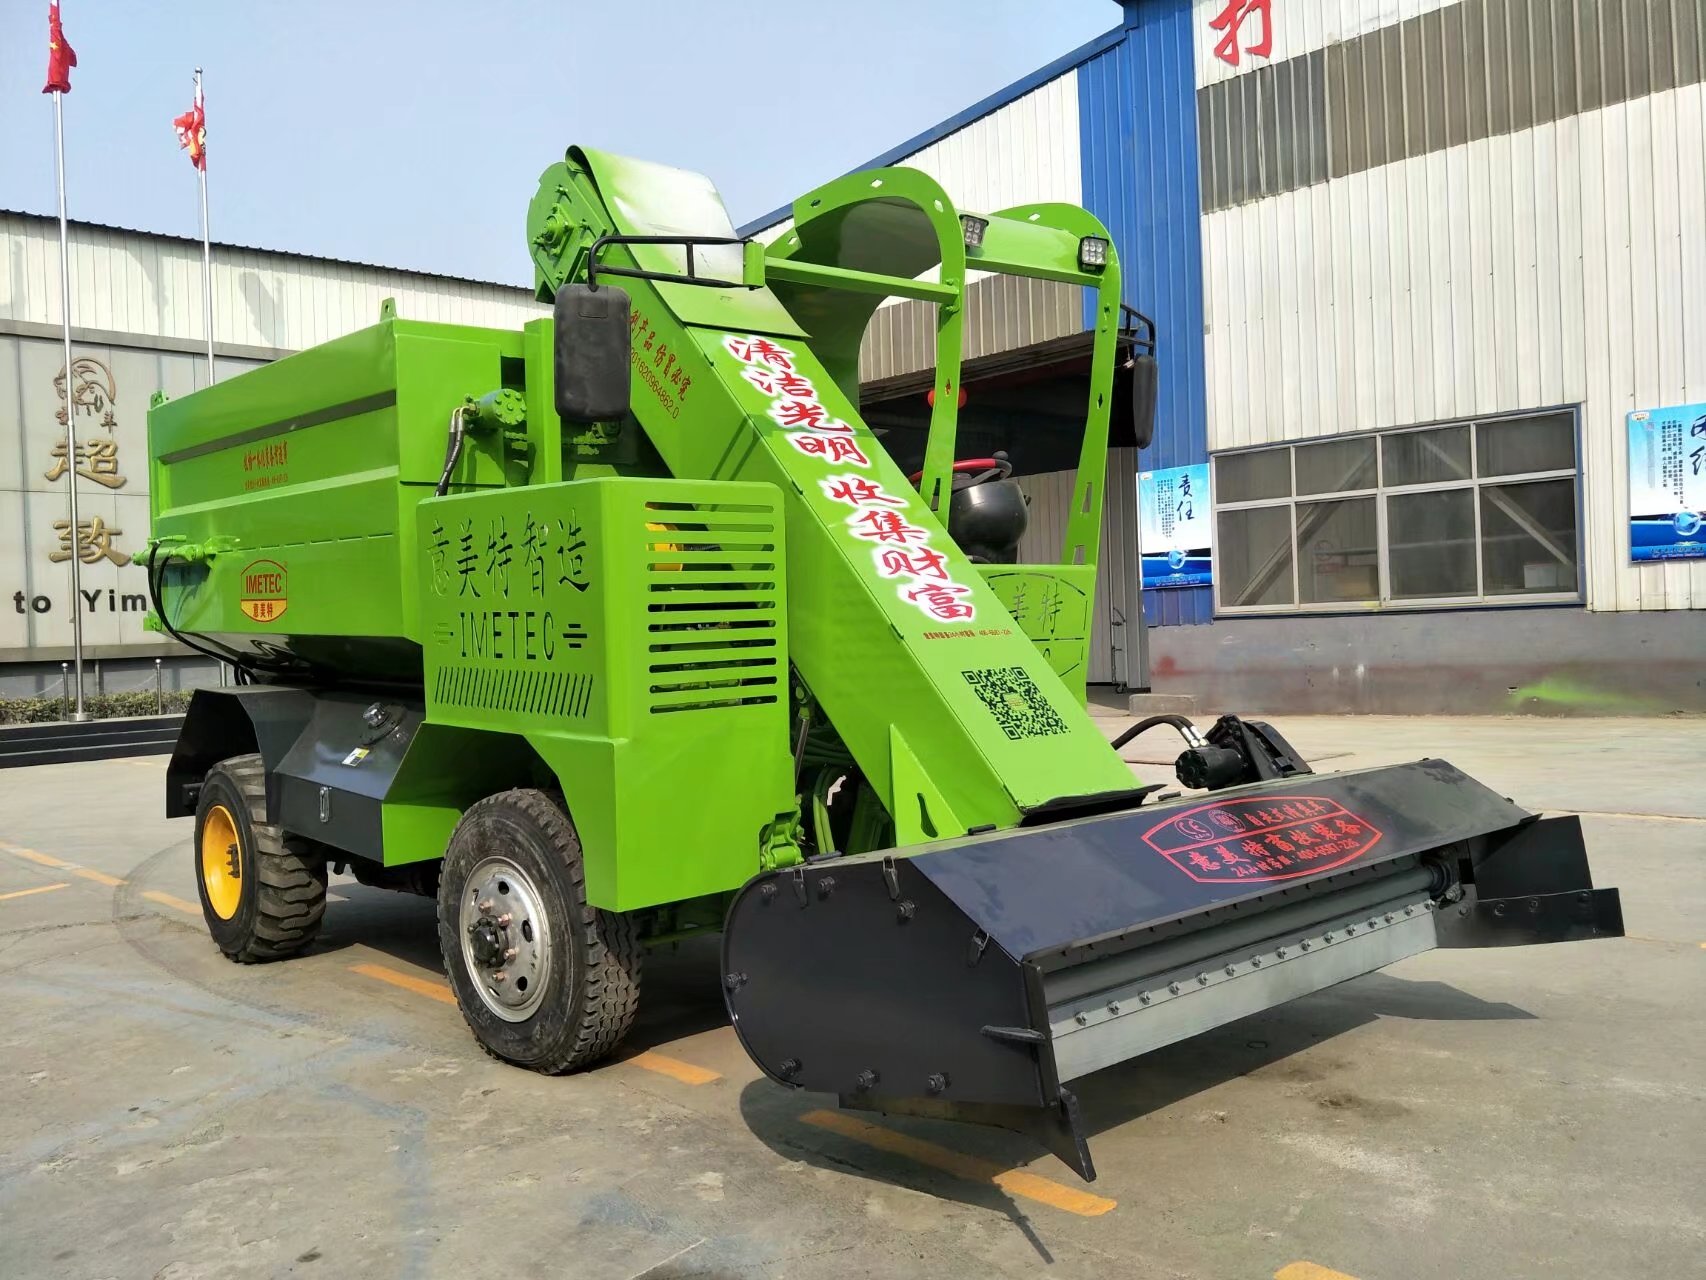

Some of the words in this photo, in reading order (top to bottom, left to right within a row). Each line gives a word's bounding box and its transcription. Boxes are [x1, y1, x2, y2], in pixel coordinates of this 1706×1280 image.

[1208, 0, 1272, 67] 打
[44, 440, 128, 489] 超
[728, 337, 869, 466] 清洁光明
[828, 476, 974, 621] 收集财富
[1176, 472, 1195, 522] 责任
[48, 515, 132, 568] 致
[427, 507, 591, 599] 意美特智造
[13, 590, 52, 614] to
[80, 588, 147, 613] Yim
[245, 573, 282, 594] IMETEC
[460, 611, 555, 661] IMETEC
[1188, 818, 1361, 872] 意美特畜牧装备
